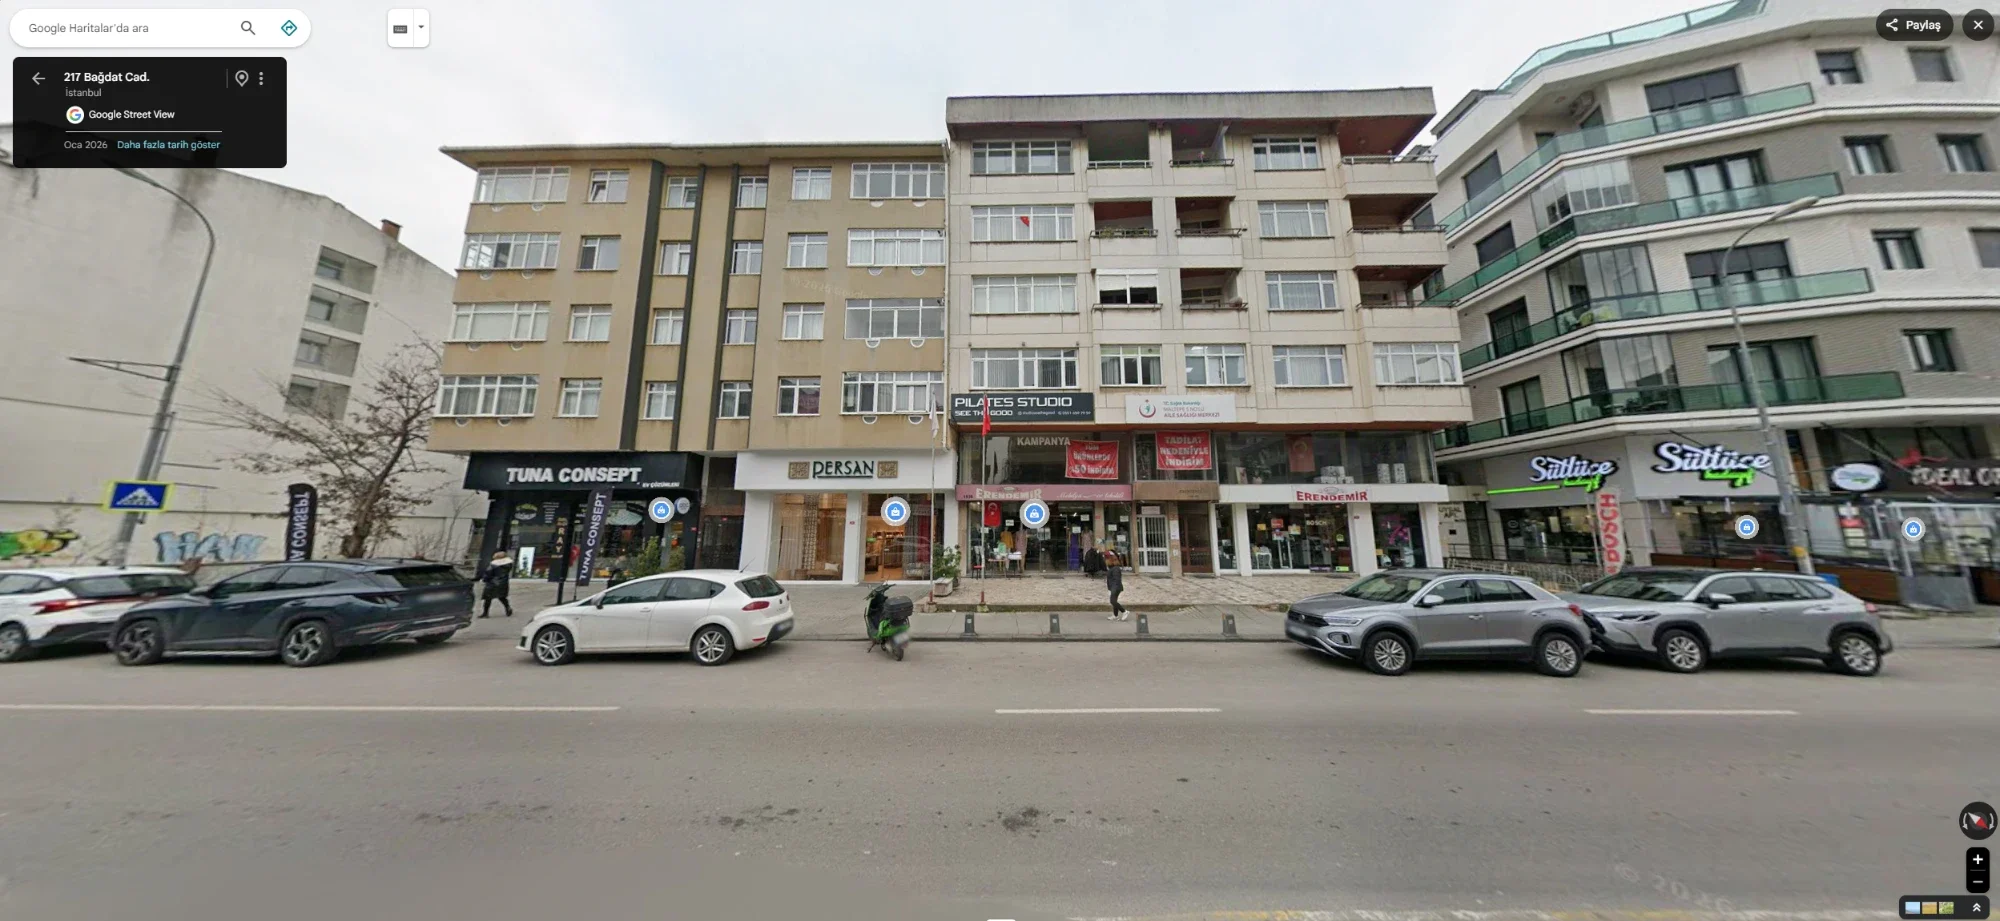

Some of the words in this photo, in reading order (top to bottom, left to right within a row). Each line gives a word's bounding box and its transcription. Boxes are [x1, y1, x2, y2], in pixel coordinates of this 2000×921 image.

[955, 397, 1014, 408] PILATES
[1017, 396, 1073, 407] STUDIO
[991, 409, 1014, 417] GOOD
[1017, 436, 1071, 446] KAMPANYA
[1164, 435, 1204, 445] TADİLAT
[1160, 445, 1209, 455] NEDENİYLE
[1165, 456, 1204, 467] İNDİRİM
[507, 467, 554, 483] TUNA
[558, 467, 642, 483] CONSEPT
[812, 461, 874, 478] PERSAN
[1087, 464, 1115, 475] İNDİRİM
[1296, 490, 1368, 501] ERENDEMİR
[1600, 493, 1620, 562] BOSCH
[579, 549, 593, 581] TUNA
[587, 493, 607, 547] CONSEPT
